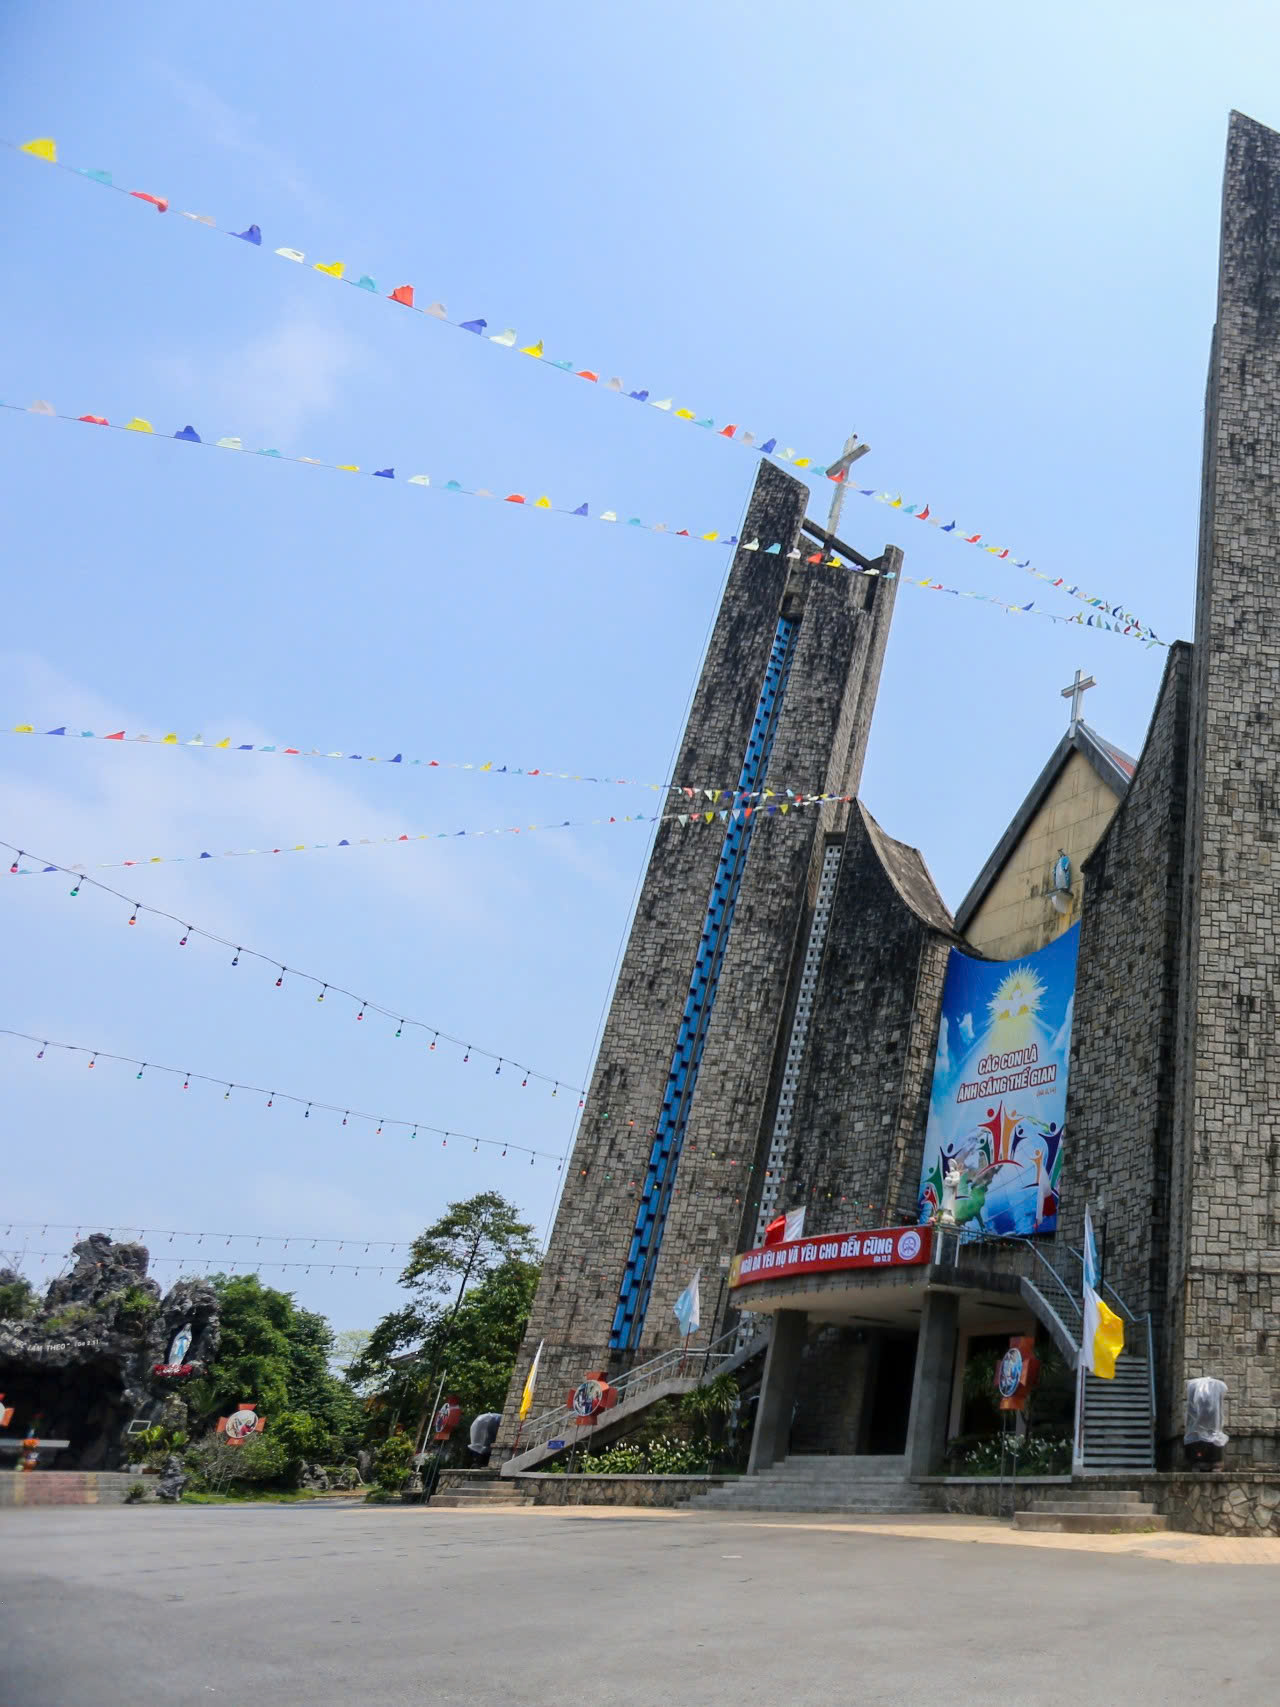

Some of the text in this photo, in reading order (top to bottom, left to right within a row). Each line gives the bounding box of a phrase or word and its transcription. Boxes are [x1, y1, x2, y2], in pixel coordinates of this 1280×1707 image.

[978, 1043, 1038, 1075] CÁC CON LÀ
[957, 1064, 1057, 1103] ÁNH SÁNG THẾ GIAN
[762, 1250, 775, 1269] YÊU
[775, 1250, 787, 1268] HỌ
[801, 1243, 818, 1262] YÊU
[819, 1242, 838, 1260] CHO
[840, 1235, 861, 1257] ĐẾN
